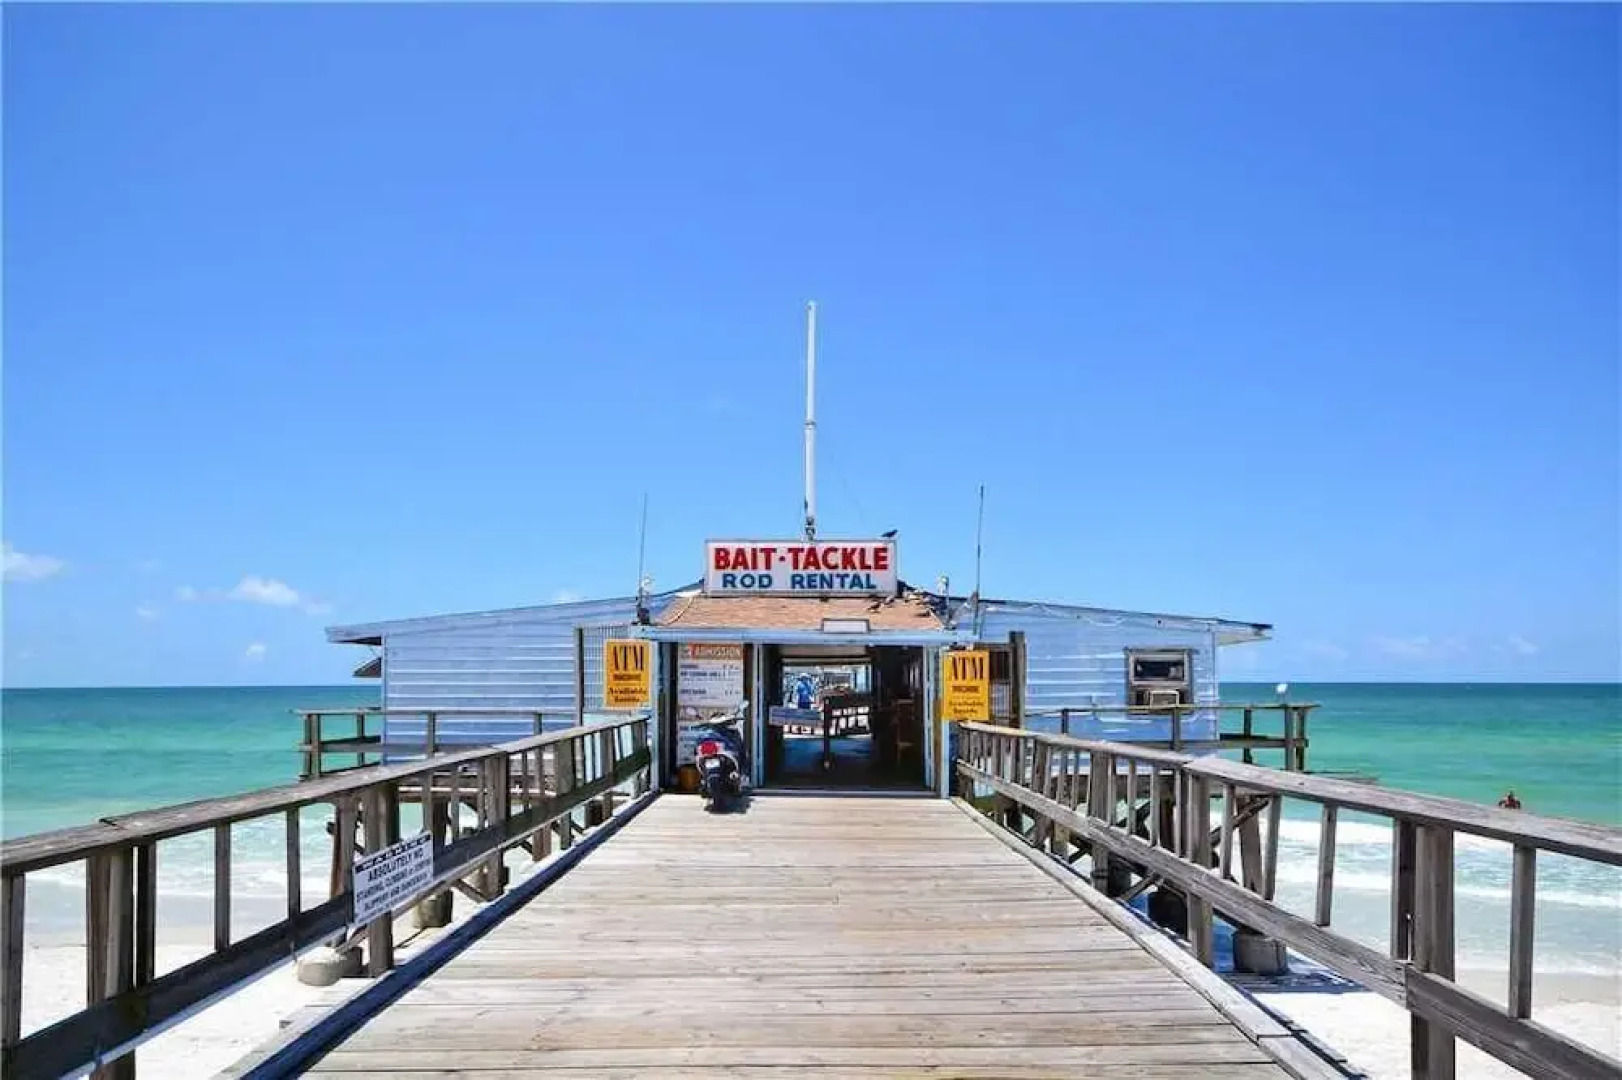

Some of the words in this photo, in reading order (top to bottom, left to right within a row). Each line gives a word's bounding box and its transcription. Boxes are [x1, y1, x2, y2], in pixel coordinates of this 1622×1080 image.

[722, 573, 773, 588] ROD
[790, 573, 877, 589] RENTAL
[612, 645, 644, 671] ATM
[950, 656, 984, 681] ATM
[368, 852, 412, 881] ABSOLUTELY
[413, 847, 423, 859] NO
